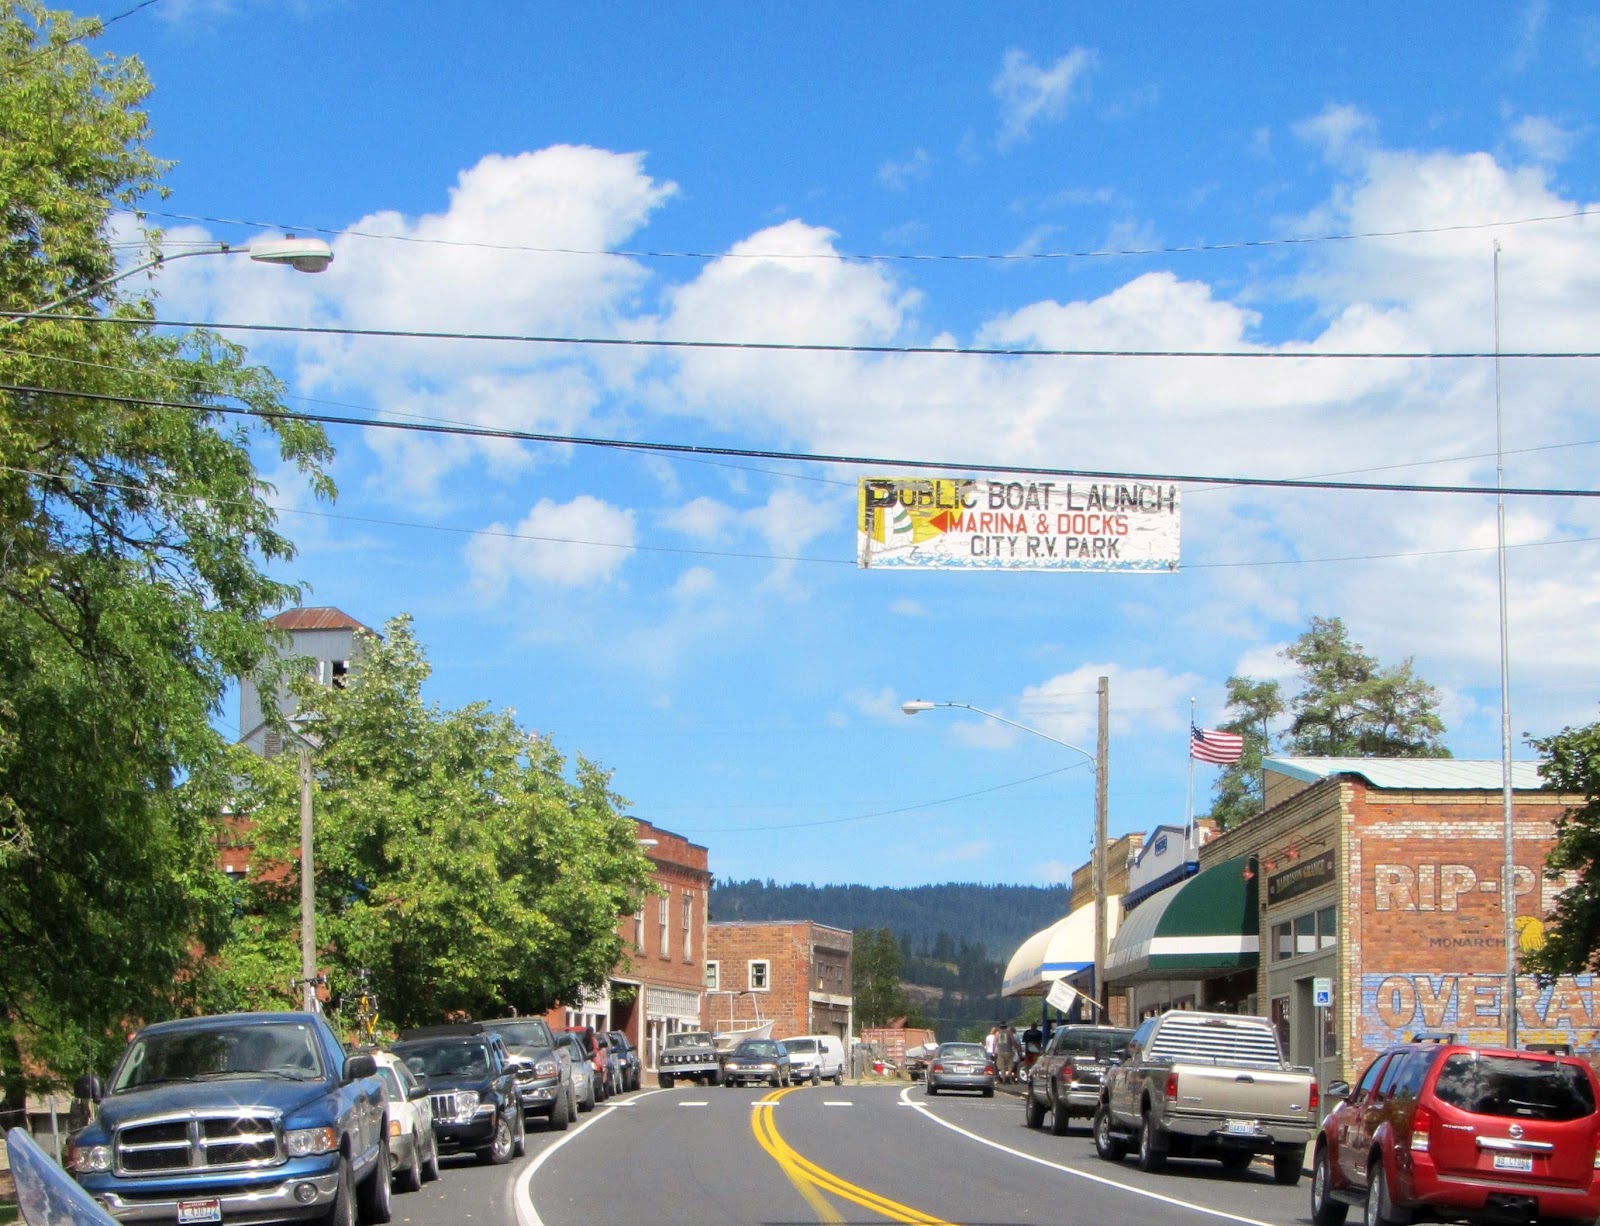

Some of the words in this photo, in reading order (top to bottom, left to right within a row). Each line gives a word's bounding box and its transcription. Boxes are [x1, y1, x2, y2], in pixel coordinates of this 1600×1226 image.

[865, 480, 978, 530] PUBLIC
[988, 482, 1055, 511] BOAT
[1067, 483, 1175, 514] LAUNCH
[949, 511, 1027, 534] MARINA
[1036, 513, 1049, 535] &
[1057, 513, 1128, 535] DOCKS
[971, 535, 1018, 557] CITY
[1026, 536, 1057, 558] R.V.
[1066, 537, 1120, 559] PARK
[1430, 937, 1506, 948] MONARCH
[1376, 975, 1600, 1030] OVERA
